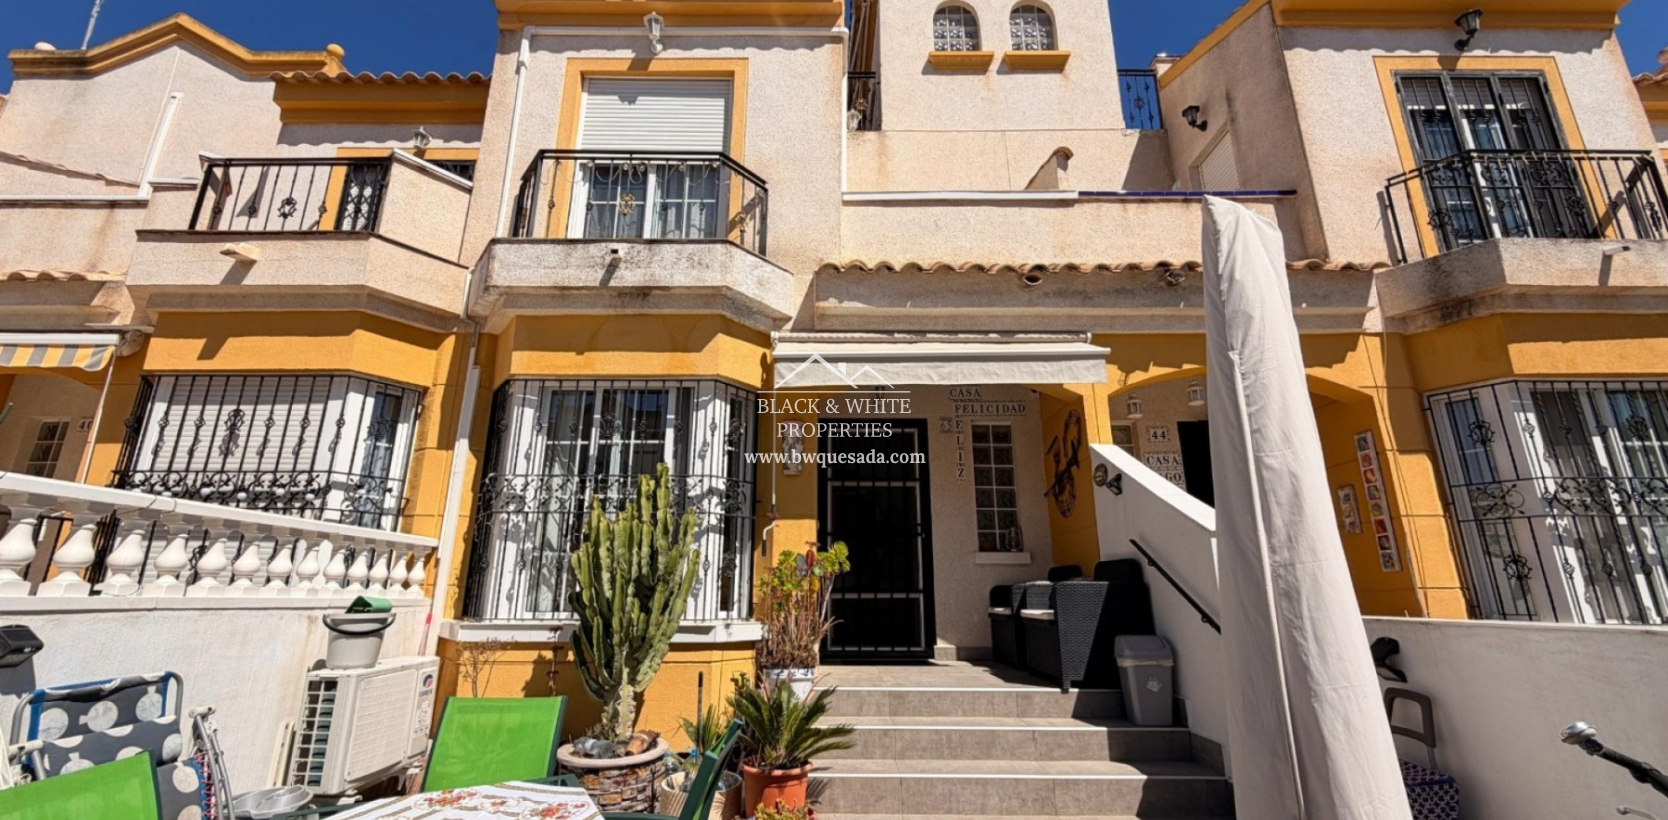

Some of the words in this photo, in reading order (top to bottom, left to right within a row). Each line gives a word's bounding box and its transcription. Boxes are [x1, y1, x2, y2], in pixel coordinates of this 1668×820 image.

[949, 388, 981, 398] CASA
[954, 403, 1026, 414] FELICIDAD
[1151, 430, 1167, 440] 44
[1146, 455, 1179, 466] CASA
